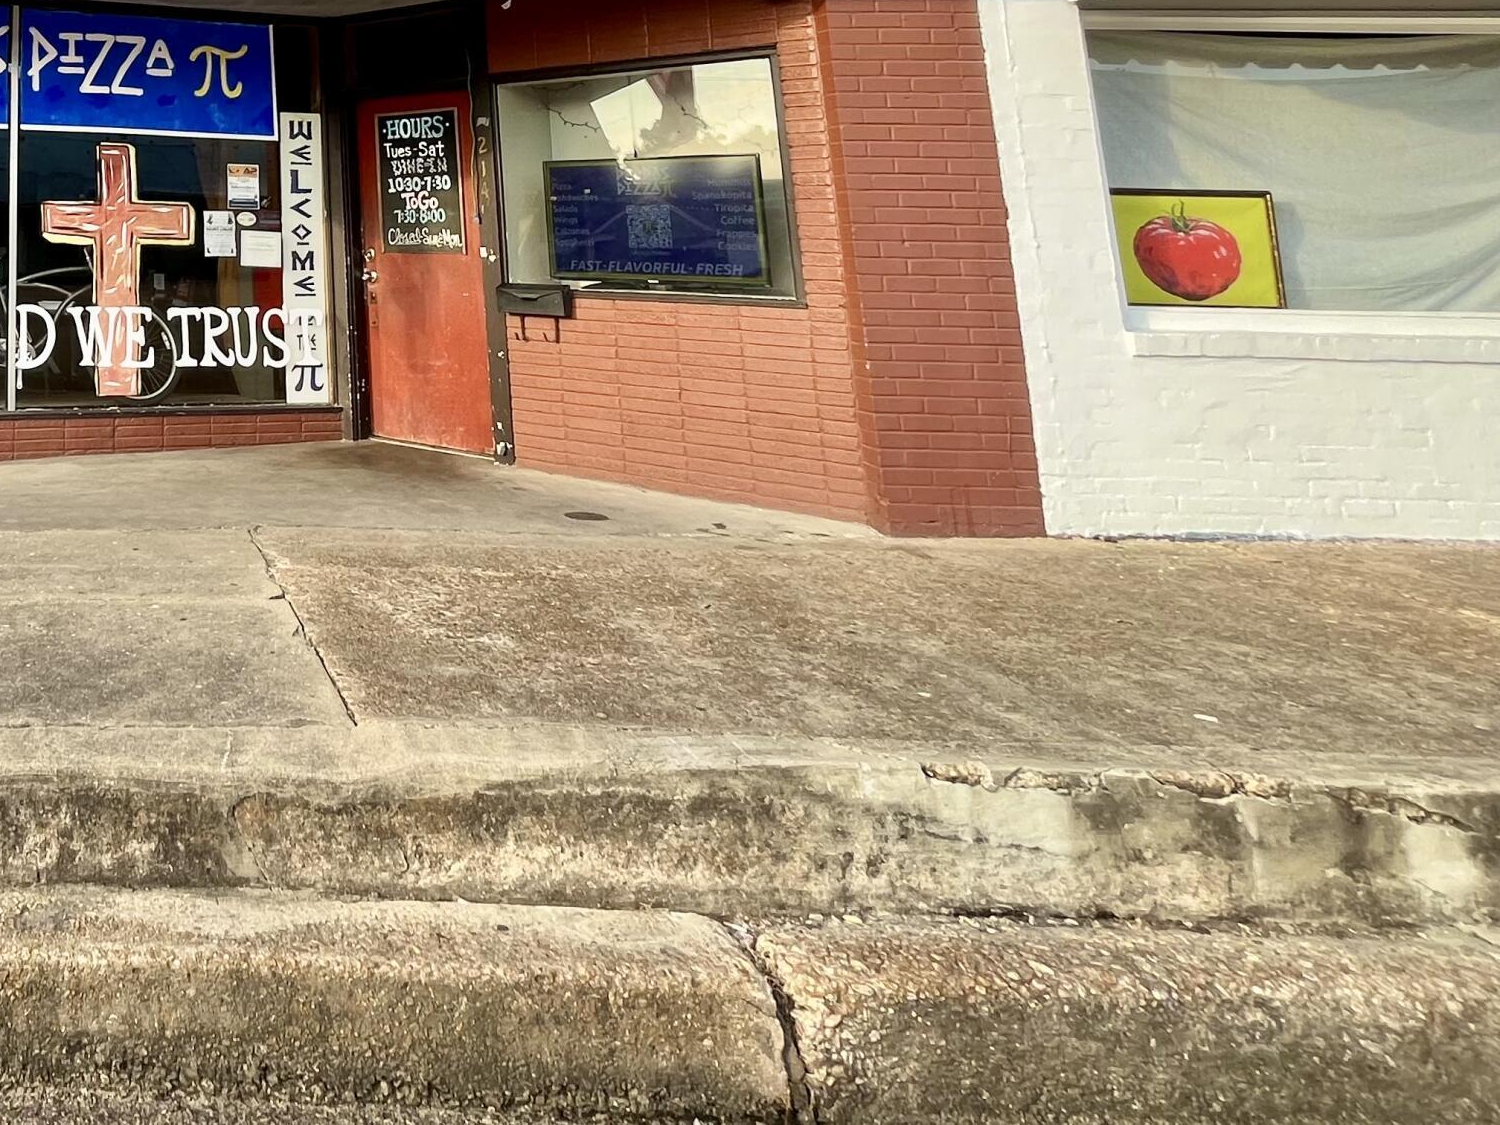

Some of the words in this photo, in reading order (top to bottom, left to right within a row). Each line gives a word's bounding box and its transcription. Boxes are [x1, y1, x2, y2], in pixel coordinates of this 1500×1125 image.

[26, 26, 175, 96] PIZZA
[385, 115, 444, 140] HOURS
[288, 119, 317, 297] WELCOME
[66, 306, 157, 369] WE
[166, 305, 324, 369] TRUST
